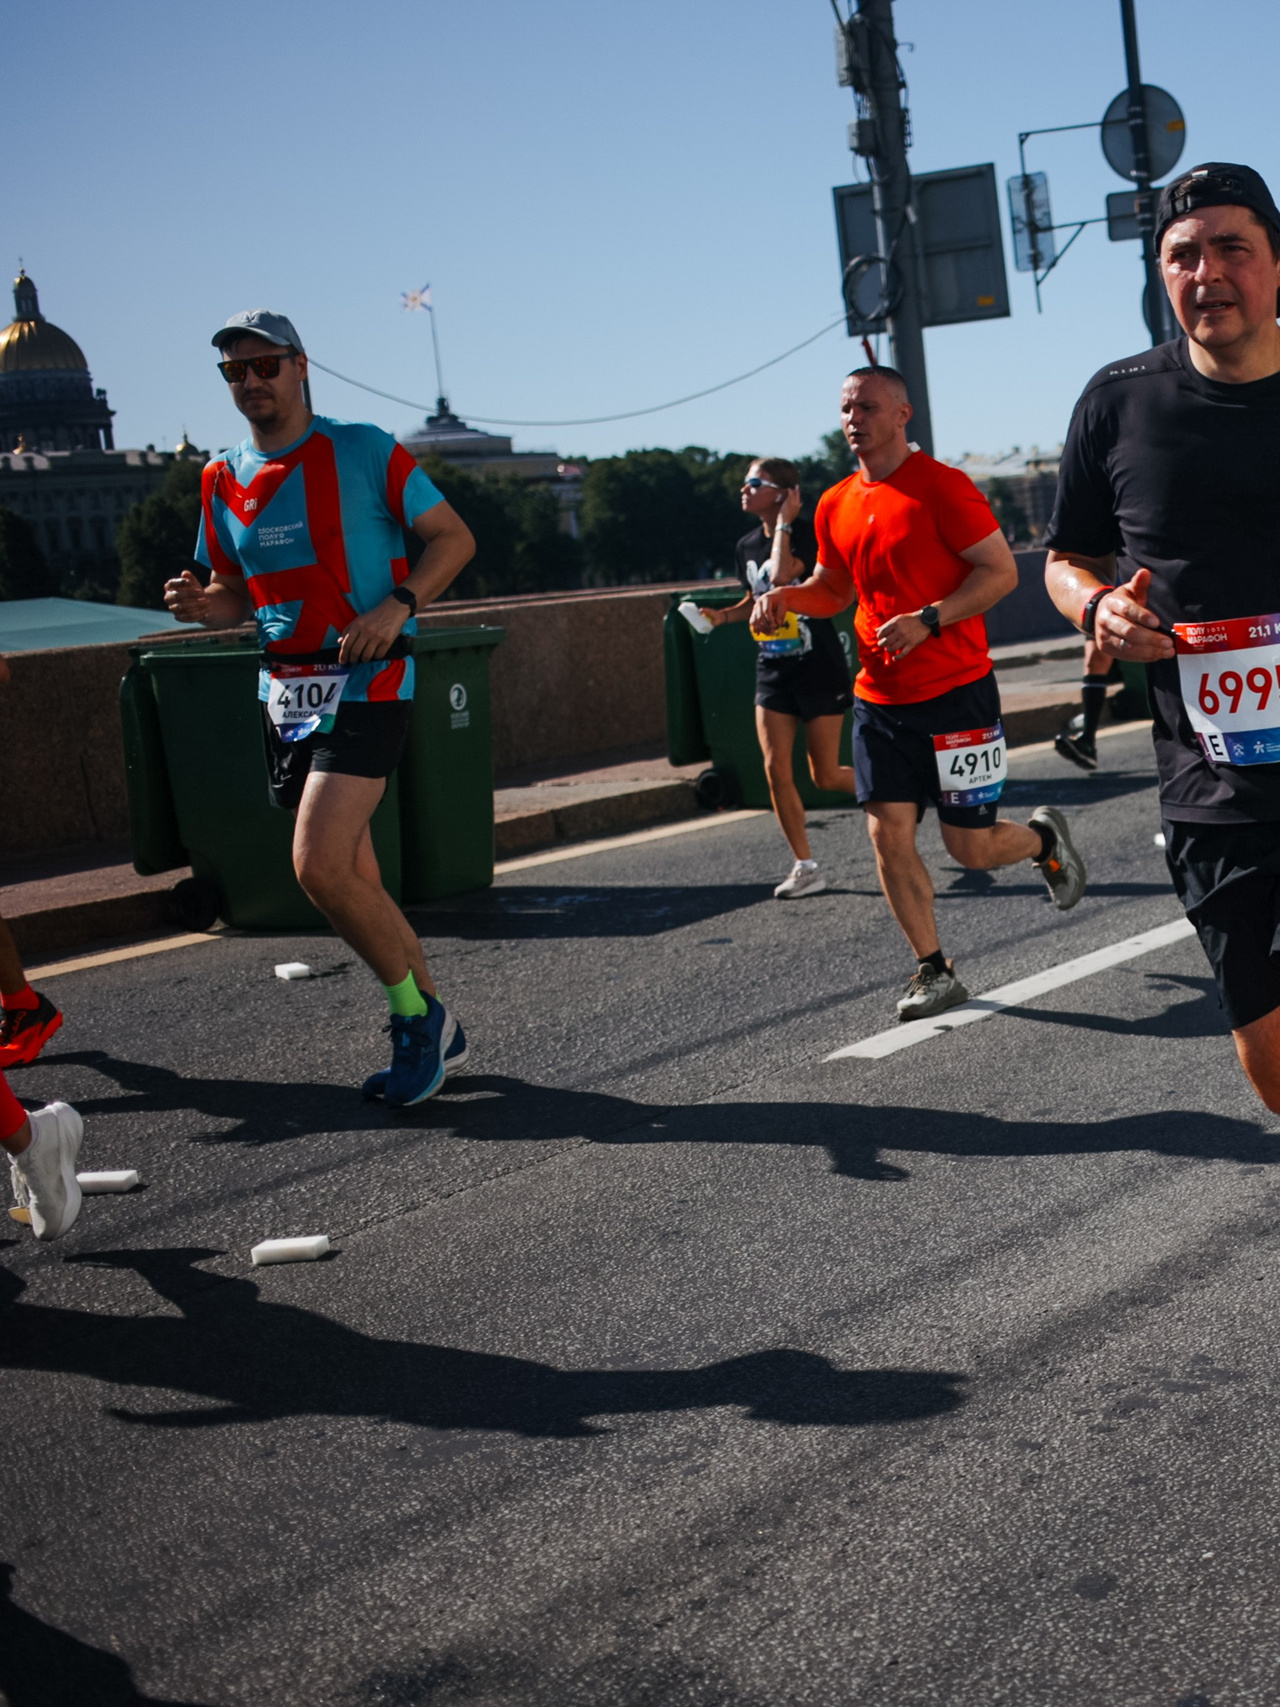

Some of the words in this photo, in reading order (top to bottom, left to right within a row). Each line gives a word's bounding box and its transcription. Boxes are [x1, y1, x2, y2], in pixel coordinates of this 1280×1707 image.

[259, 538, 295, 548] МАРАФОН
[1248, 624, 1271, 638] 21,1
[276, 682, 338, 709] 4104
[949, 746, 1001, 778] 4910
